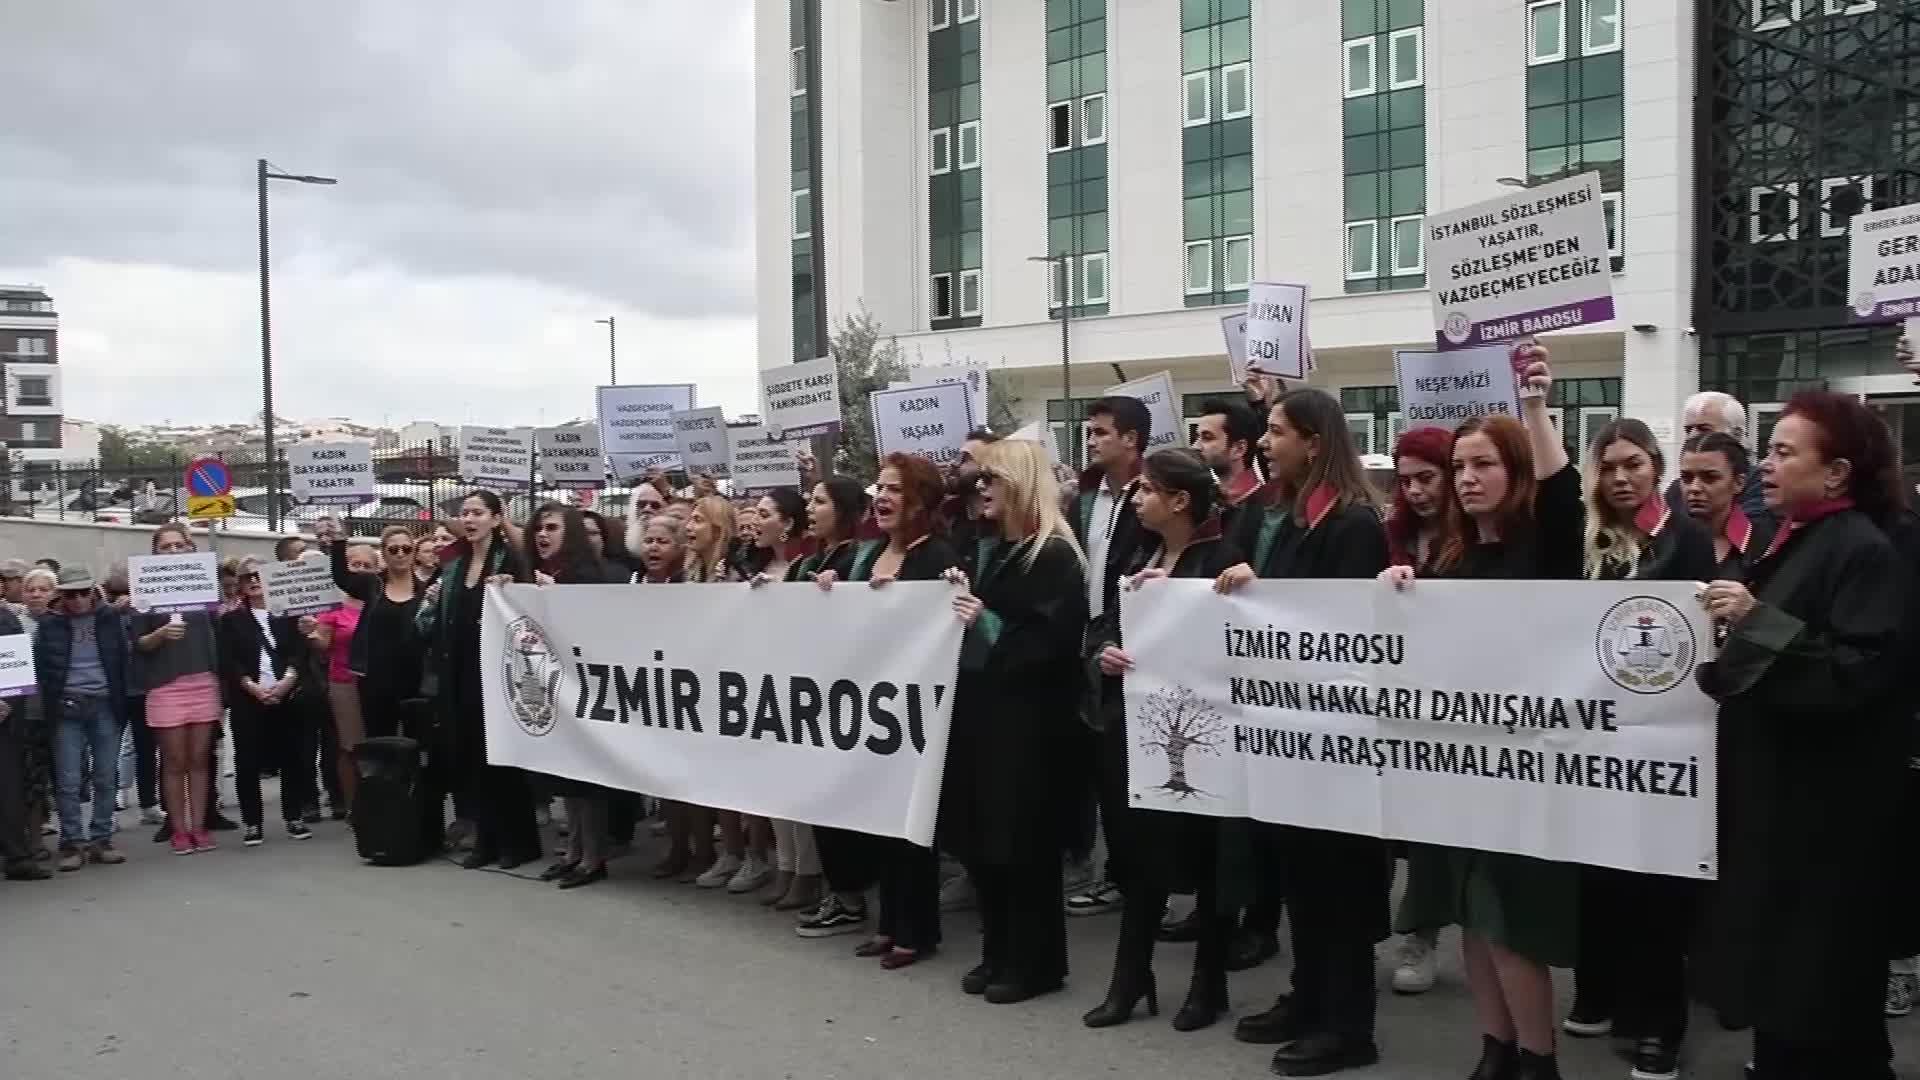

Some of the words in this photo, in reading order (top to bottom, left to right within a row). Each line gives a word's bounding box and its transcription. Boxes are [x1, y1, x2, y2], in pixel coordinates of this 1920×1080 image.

[1431, 214, 1498, 241] İSTANBUL
[1501, 184, 1593, 223] SÖZLEŞMESİ
[1478, 223, 1544, 248] YAŞATIR,
[1879, 235, 1918, 257] GER
[1451, 236, 1580, 280] SÖZLEŞME'DEN
[1438, 255, 1601, 306] VAZGEÇMEYECEĞİZ
[1480, 319, 1521, 341] İZMİR
[1522, 308, 1582, 334] BAROSU
[1415, 369, 1490, 395] NEŞE'MİZİ
[900, 396, 939, 413] KADIN
[1409, 400, 1510, 420] ÖLDÜRDÜLER
[900, 423, 944, 440] YAŞAM
[312, 450, 346, 460] KADIN
[1225, 622, 1291, 661] İZMİR
[1300, 631, 1403, 665] BAROSU
[573, 646, 703, 733] İZMİR
[719, 670, 945, 756] BAROSU
[1231, 677, 1299, 710] KADIN
[1308, 682, 1421, 721] HAKLARI
[1431, 690, 1569, 735] DANIŞMA
[1575, 699, 1618, 733] VE
[1234, 724, 1313, 762] HUKUK
[1320, 734, 1545, 784] ARAŞTIRMALARI
[1555, 752, 1698, 799] MERKEZİ
